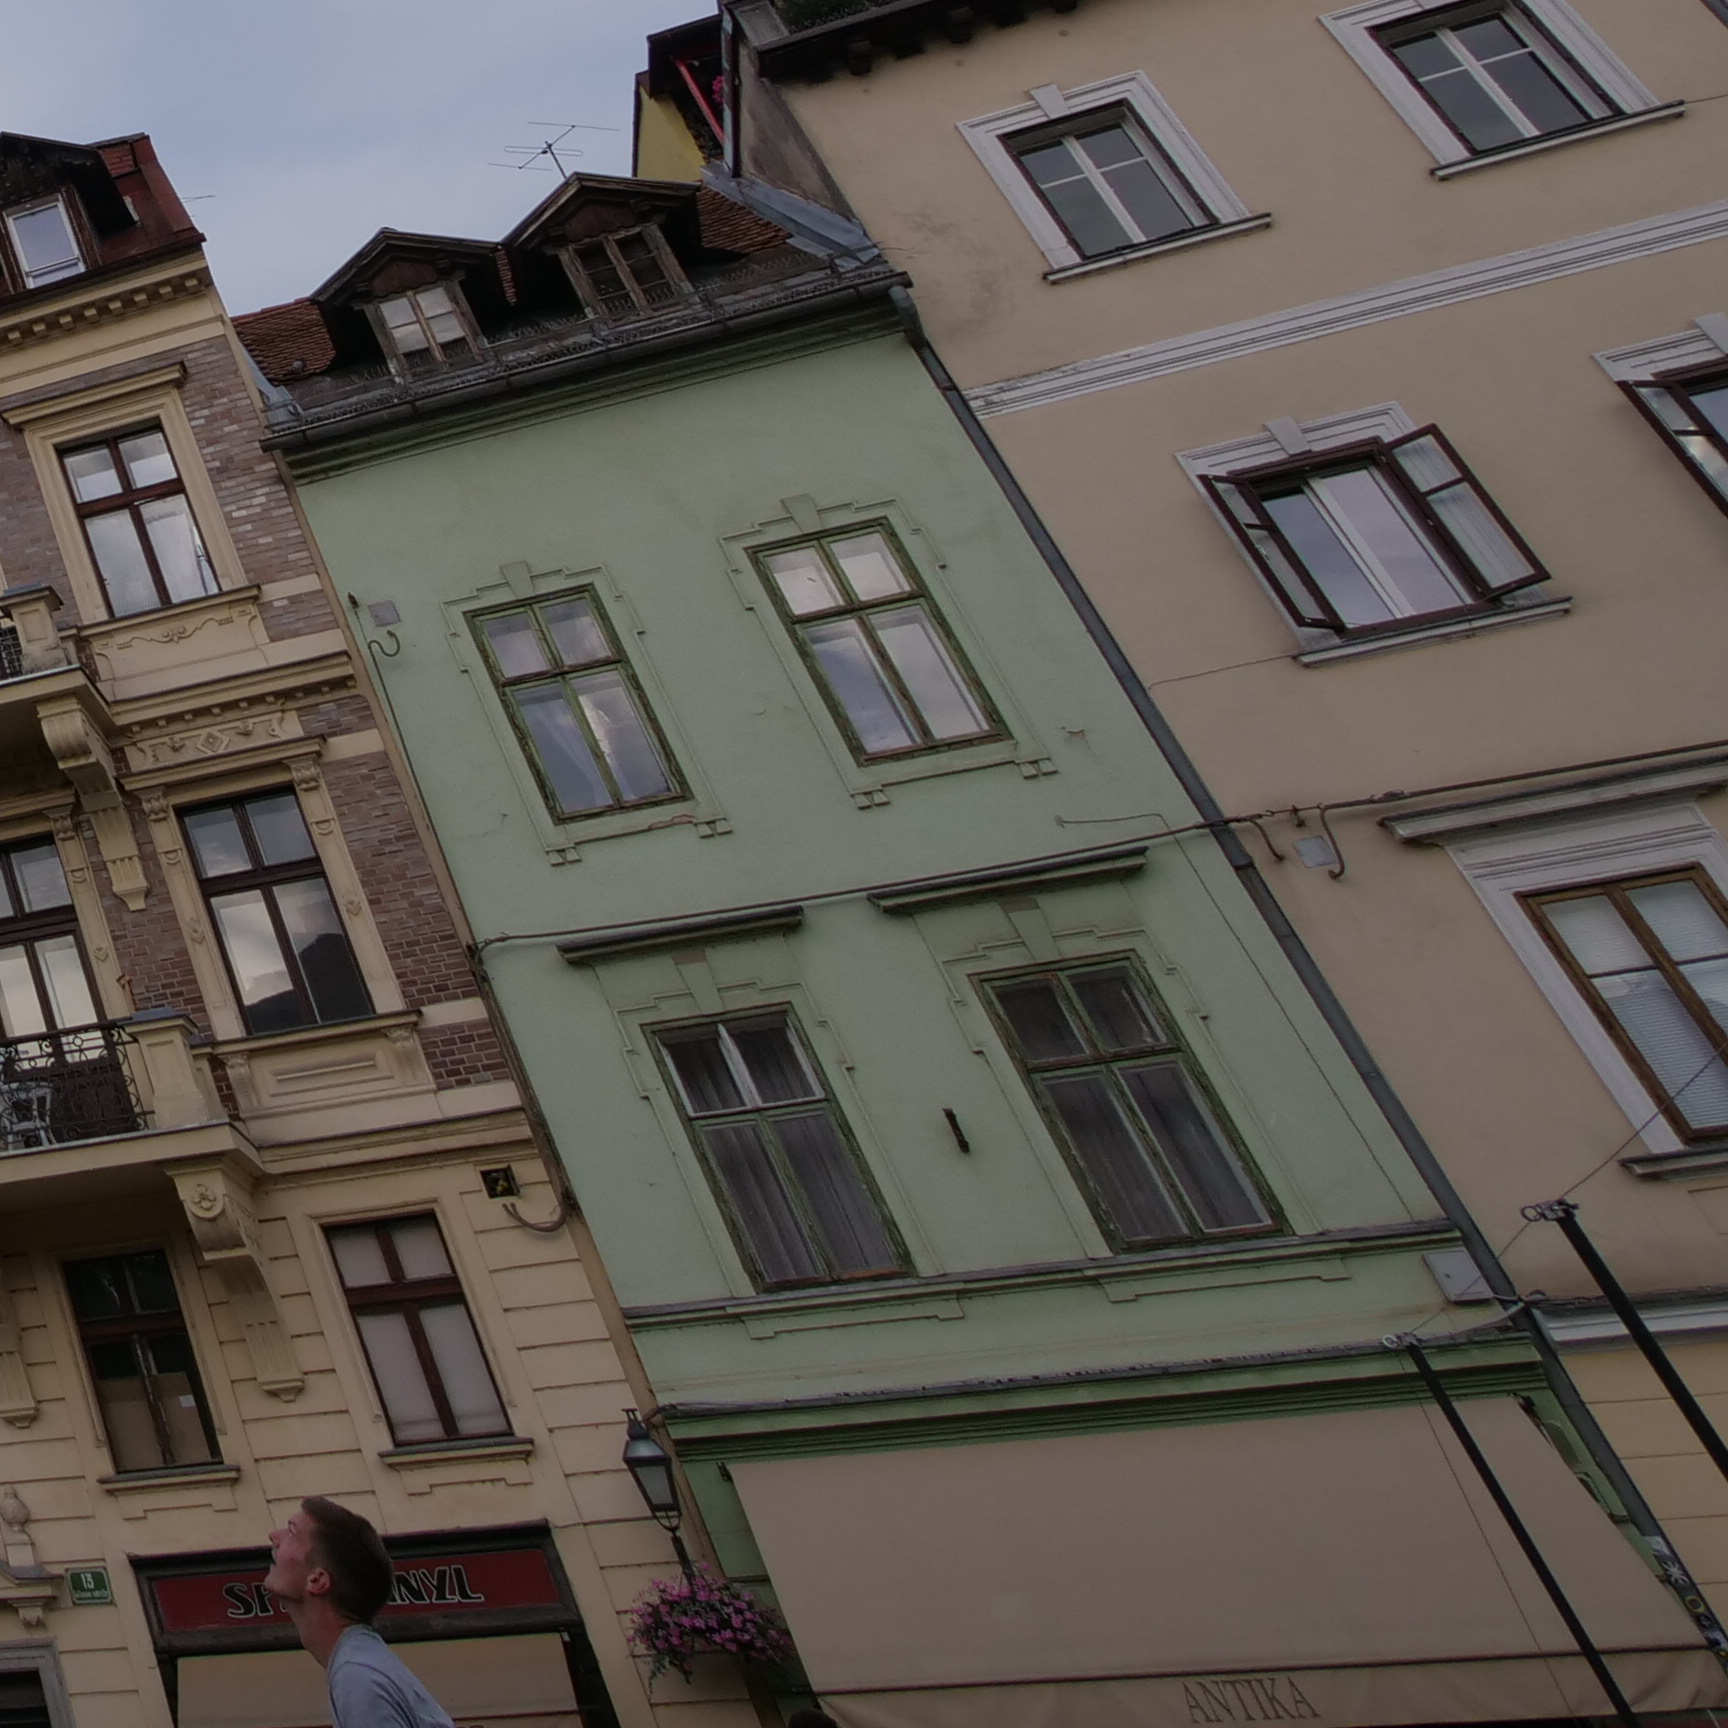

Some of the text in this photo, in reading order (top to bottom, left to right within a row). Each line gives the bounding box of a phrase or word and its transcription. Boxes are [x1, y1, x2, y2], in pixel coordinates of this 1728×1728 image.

[223, 1564, 485, 1619] SP NYL
[1182, 1675, 1321, 1724] ANTIKA
